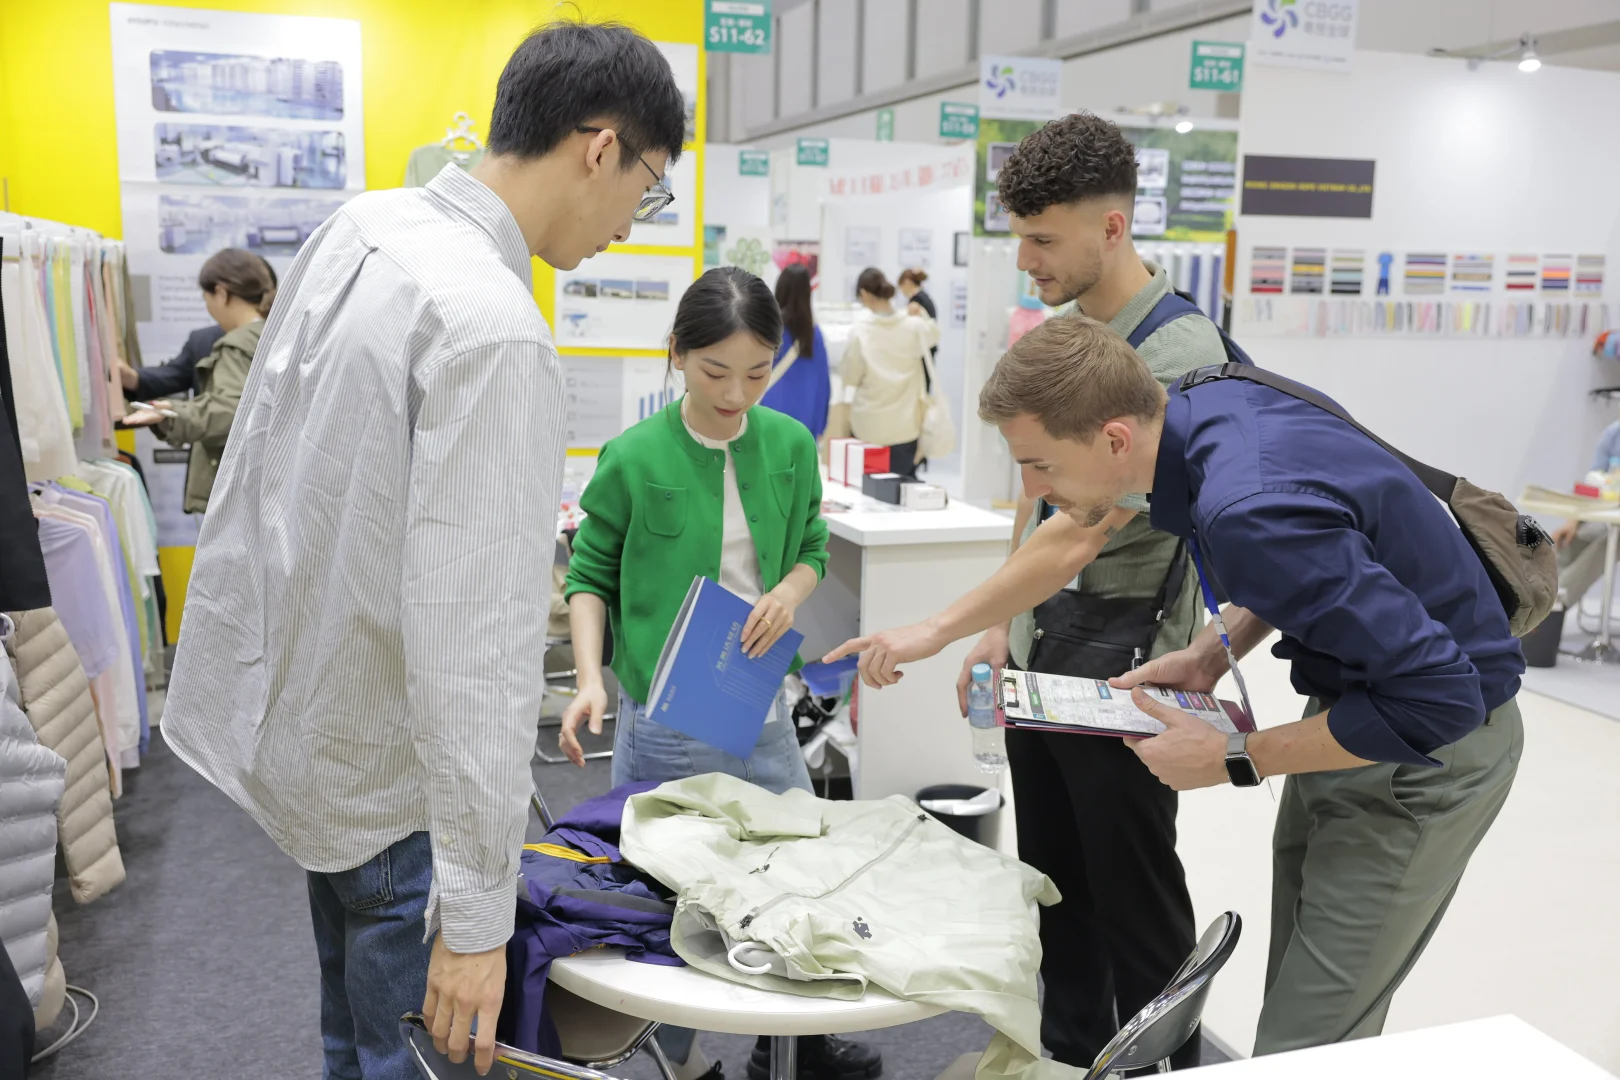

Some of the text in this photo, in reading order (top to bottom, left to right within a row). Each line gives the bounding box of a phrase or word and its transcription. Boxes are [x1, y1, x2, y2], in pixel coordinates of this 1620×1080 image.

[1304, 1, 1353, 22] CBGG
[709, 25, 765, 46] S11-62
[1193, 66, 1240, 84] S11-61
